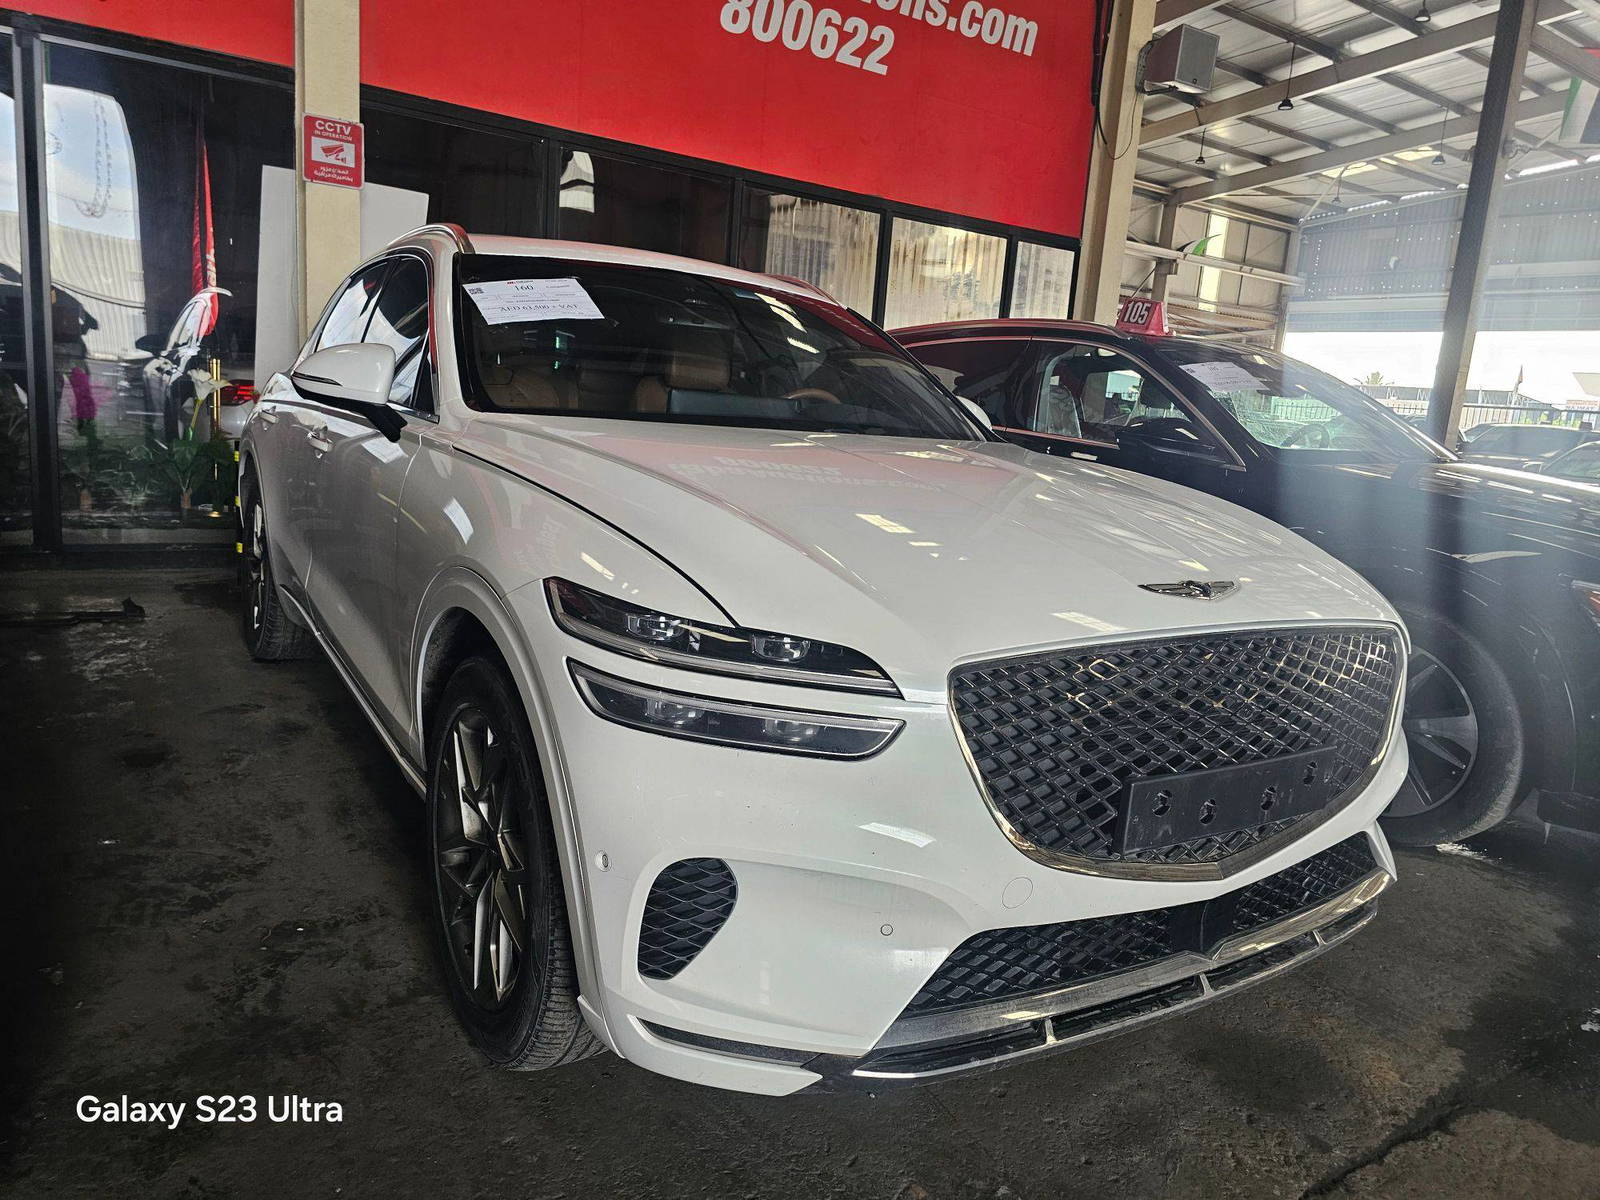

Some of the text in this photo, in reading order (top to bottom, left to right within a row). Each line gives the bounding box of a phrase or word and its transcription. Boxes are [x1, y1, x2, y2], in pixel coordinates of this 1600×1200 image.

[720, 0, 895, 75] 800622
[315, 120, 352, 135] CCTV
[322, 131, 353, 141] OPERATION
[1123, 301, 1151, 324] 105
